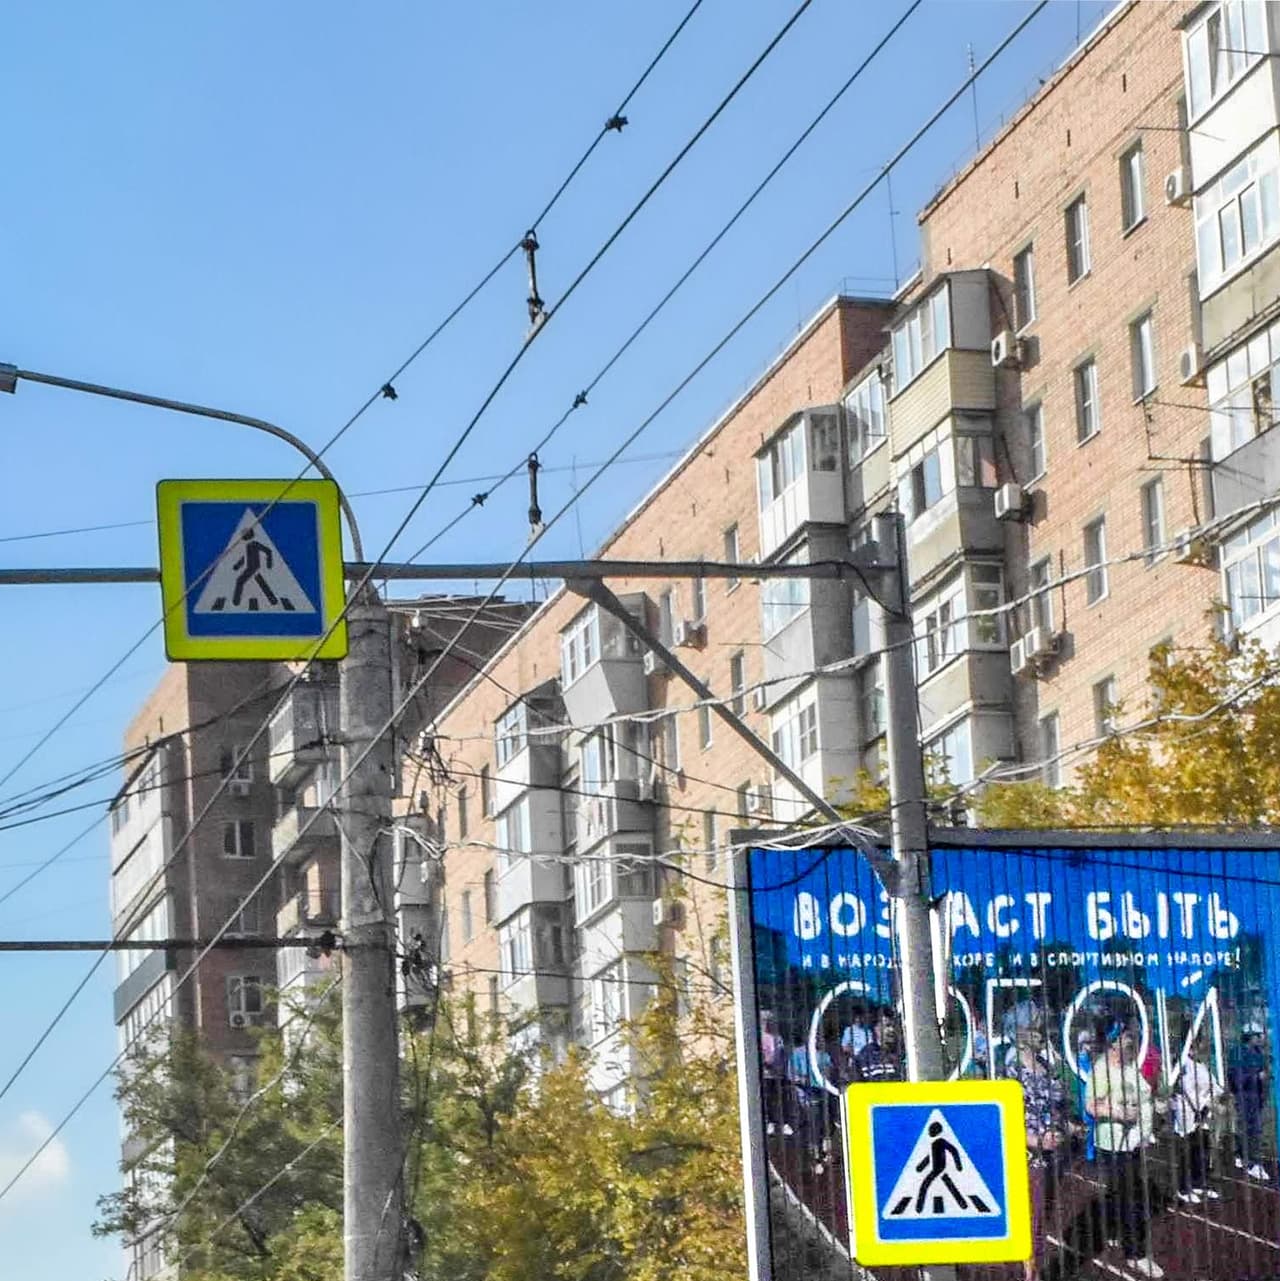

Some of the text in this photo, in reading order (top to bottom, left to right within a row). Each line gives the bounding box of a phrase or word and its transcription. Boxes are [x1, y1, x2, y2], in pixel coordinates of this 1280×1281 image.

[794, 891, 1239, 941] ВОЗАСТ БЫТЬ
[802, 954, 812, 967] И
[821, 954, 831, 968] В
[838, 953, 899, 969] НАРОД
[1048, 951, 1159, 967] СПОРТИВНОМ
